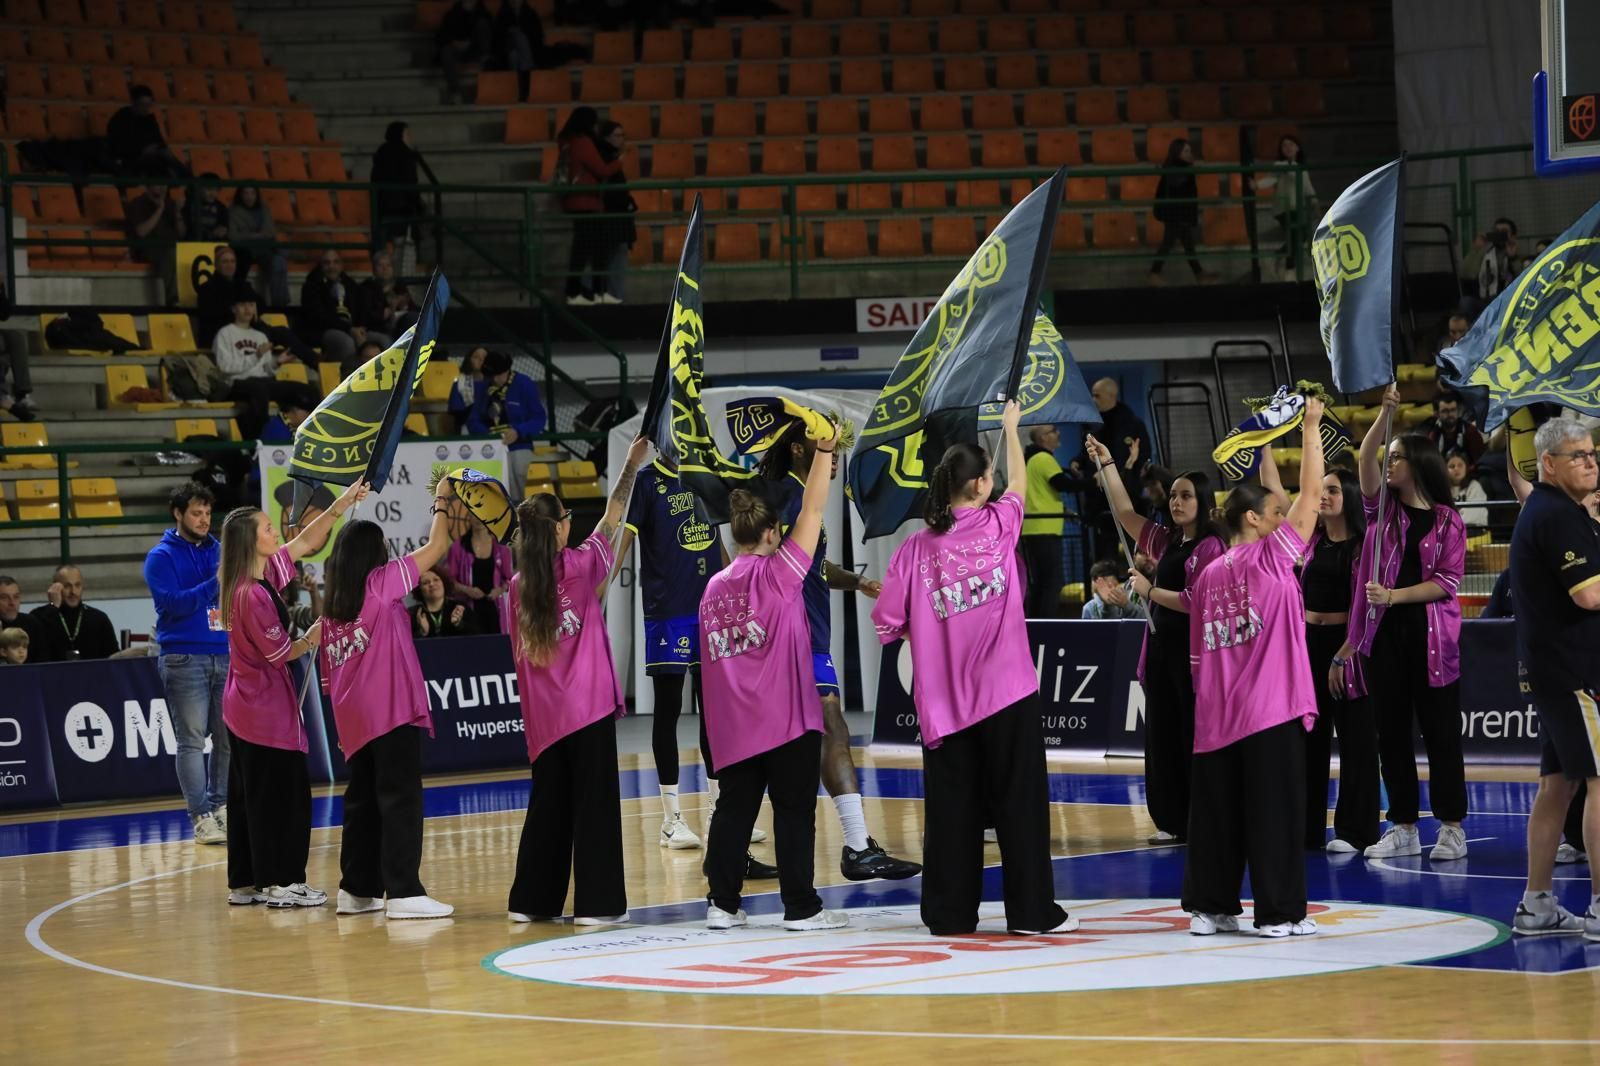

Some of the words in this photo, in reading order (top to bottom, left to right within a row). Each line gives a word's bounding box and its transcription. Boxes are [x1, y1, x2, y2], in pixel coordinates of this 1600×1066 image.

[375, 500, 402, 522] OS
[697, 558, 707, 575] 3
[924, 552, 1003, 589] PASOS
